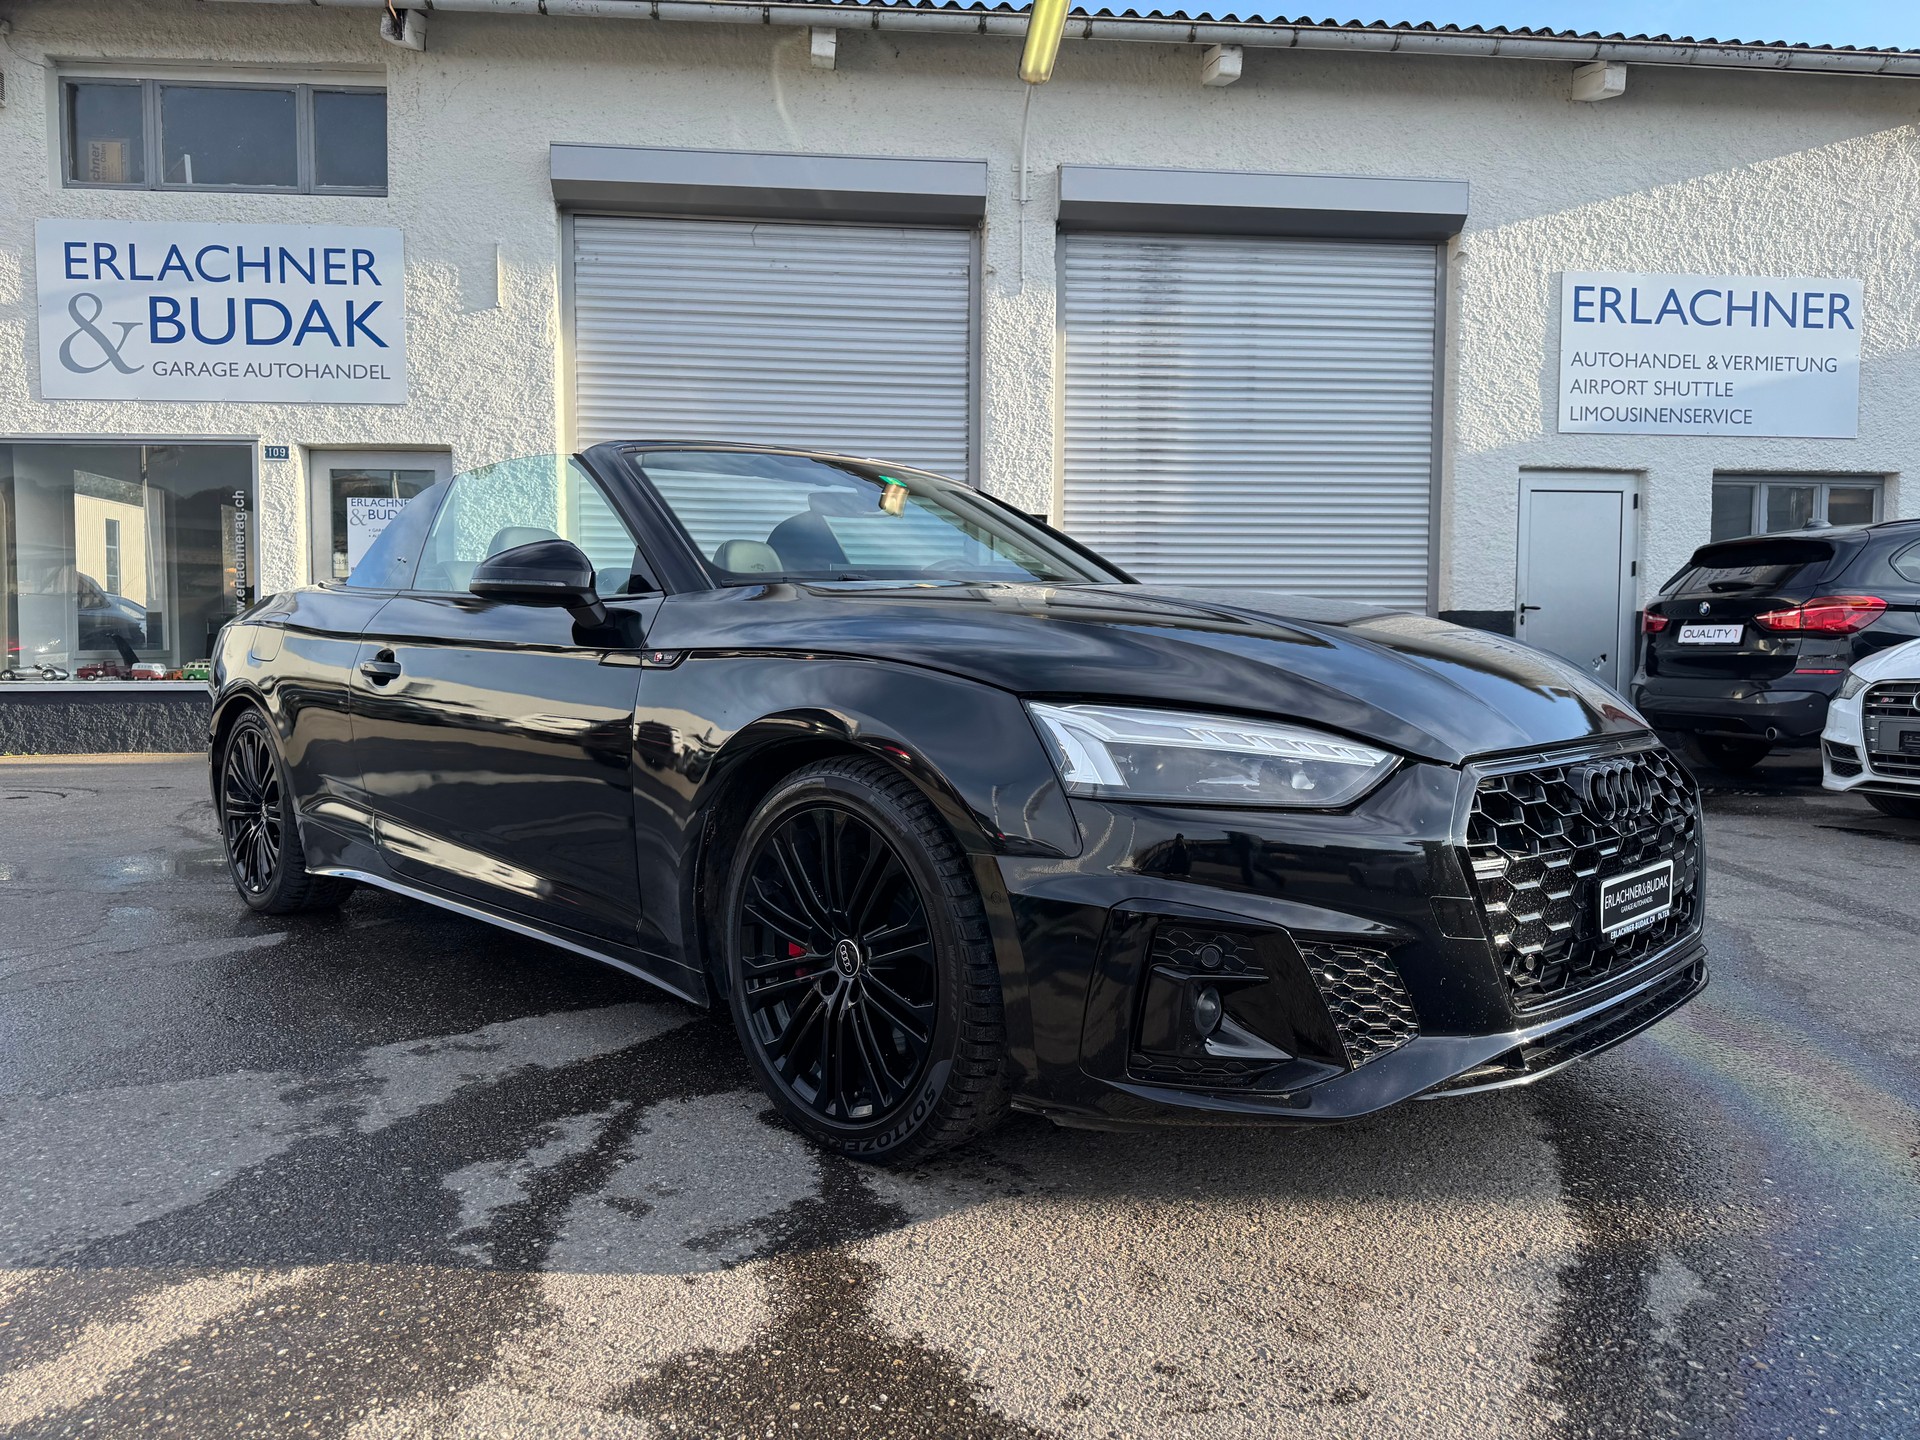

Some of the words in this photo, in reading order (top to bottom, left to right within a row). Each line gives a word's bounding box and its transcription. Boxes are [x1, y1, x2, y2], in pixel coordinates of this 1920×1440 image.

[63, 241, 382, 287] ERLACHNER
[1572, 285, 1855, 330] ERLACHNER
[58, 292, 145, 375] &
[148, 295, 390, 348] BUDAK
[152, 360, 239, 378] GARAGE
[243, 362, 391, 380] AUTOHANDEL
[1570, 351, 1701, 370] AUTOHANDEL
[1706, 354, 1719, 371] &
[1722, 355, 1838, 374] VERMIETUNG
[1569, 379, 1648, 396] AIRPORT
[1654, 380, 1734, 398] SHUTTLE
[1569, 406, 1753, 425] LIMOUSINENSERVICE
[268, 447, 286, 457] 109
[351, 498, 410, 508] ERLACHNE
[350, 509, 367, 526] &
[368, 509, 398, 520] BUD
[232, 490, 248, 615] w.erlachnerag.ch
[1683, 629, 1732, 638] QUALITY
[1734, 629, 1738, 638] 1
